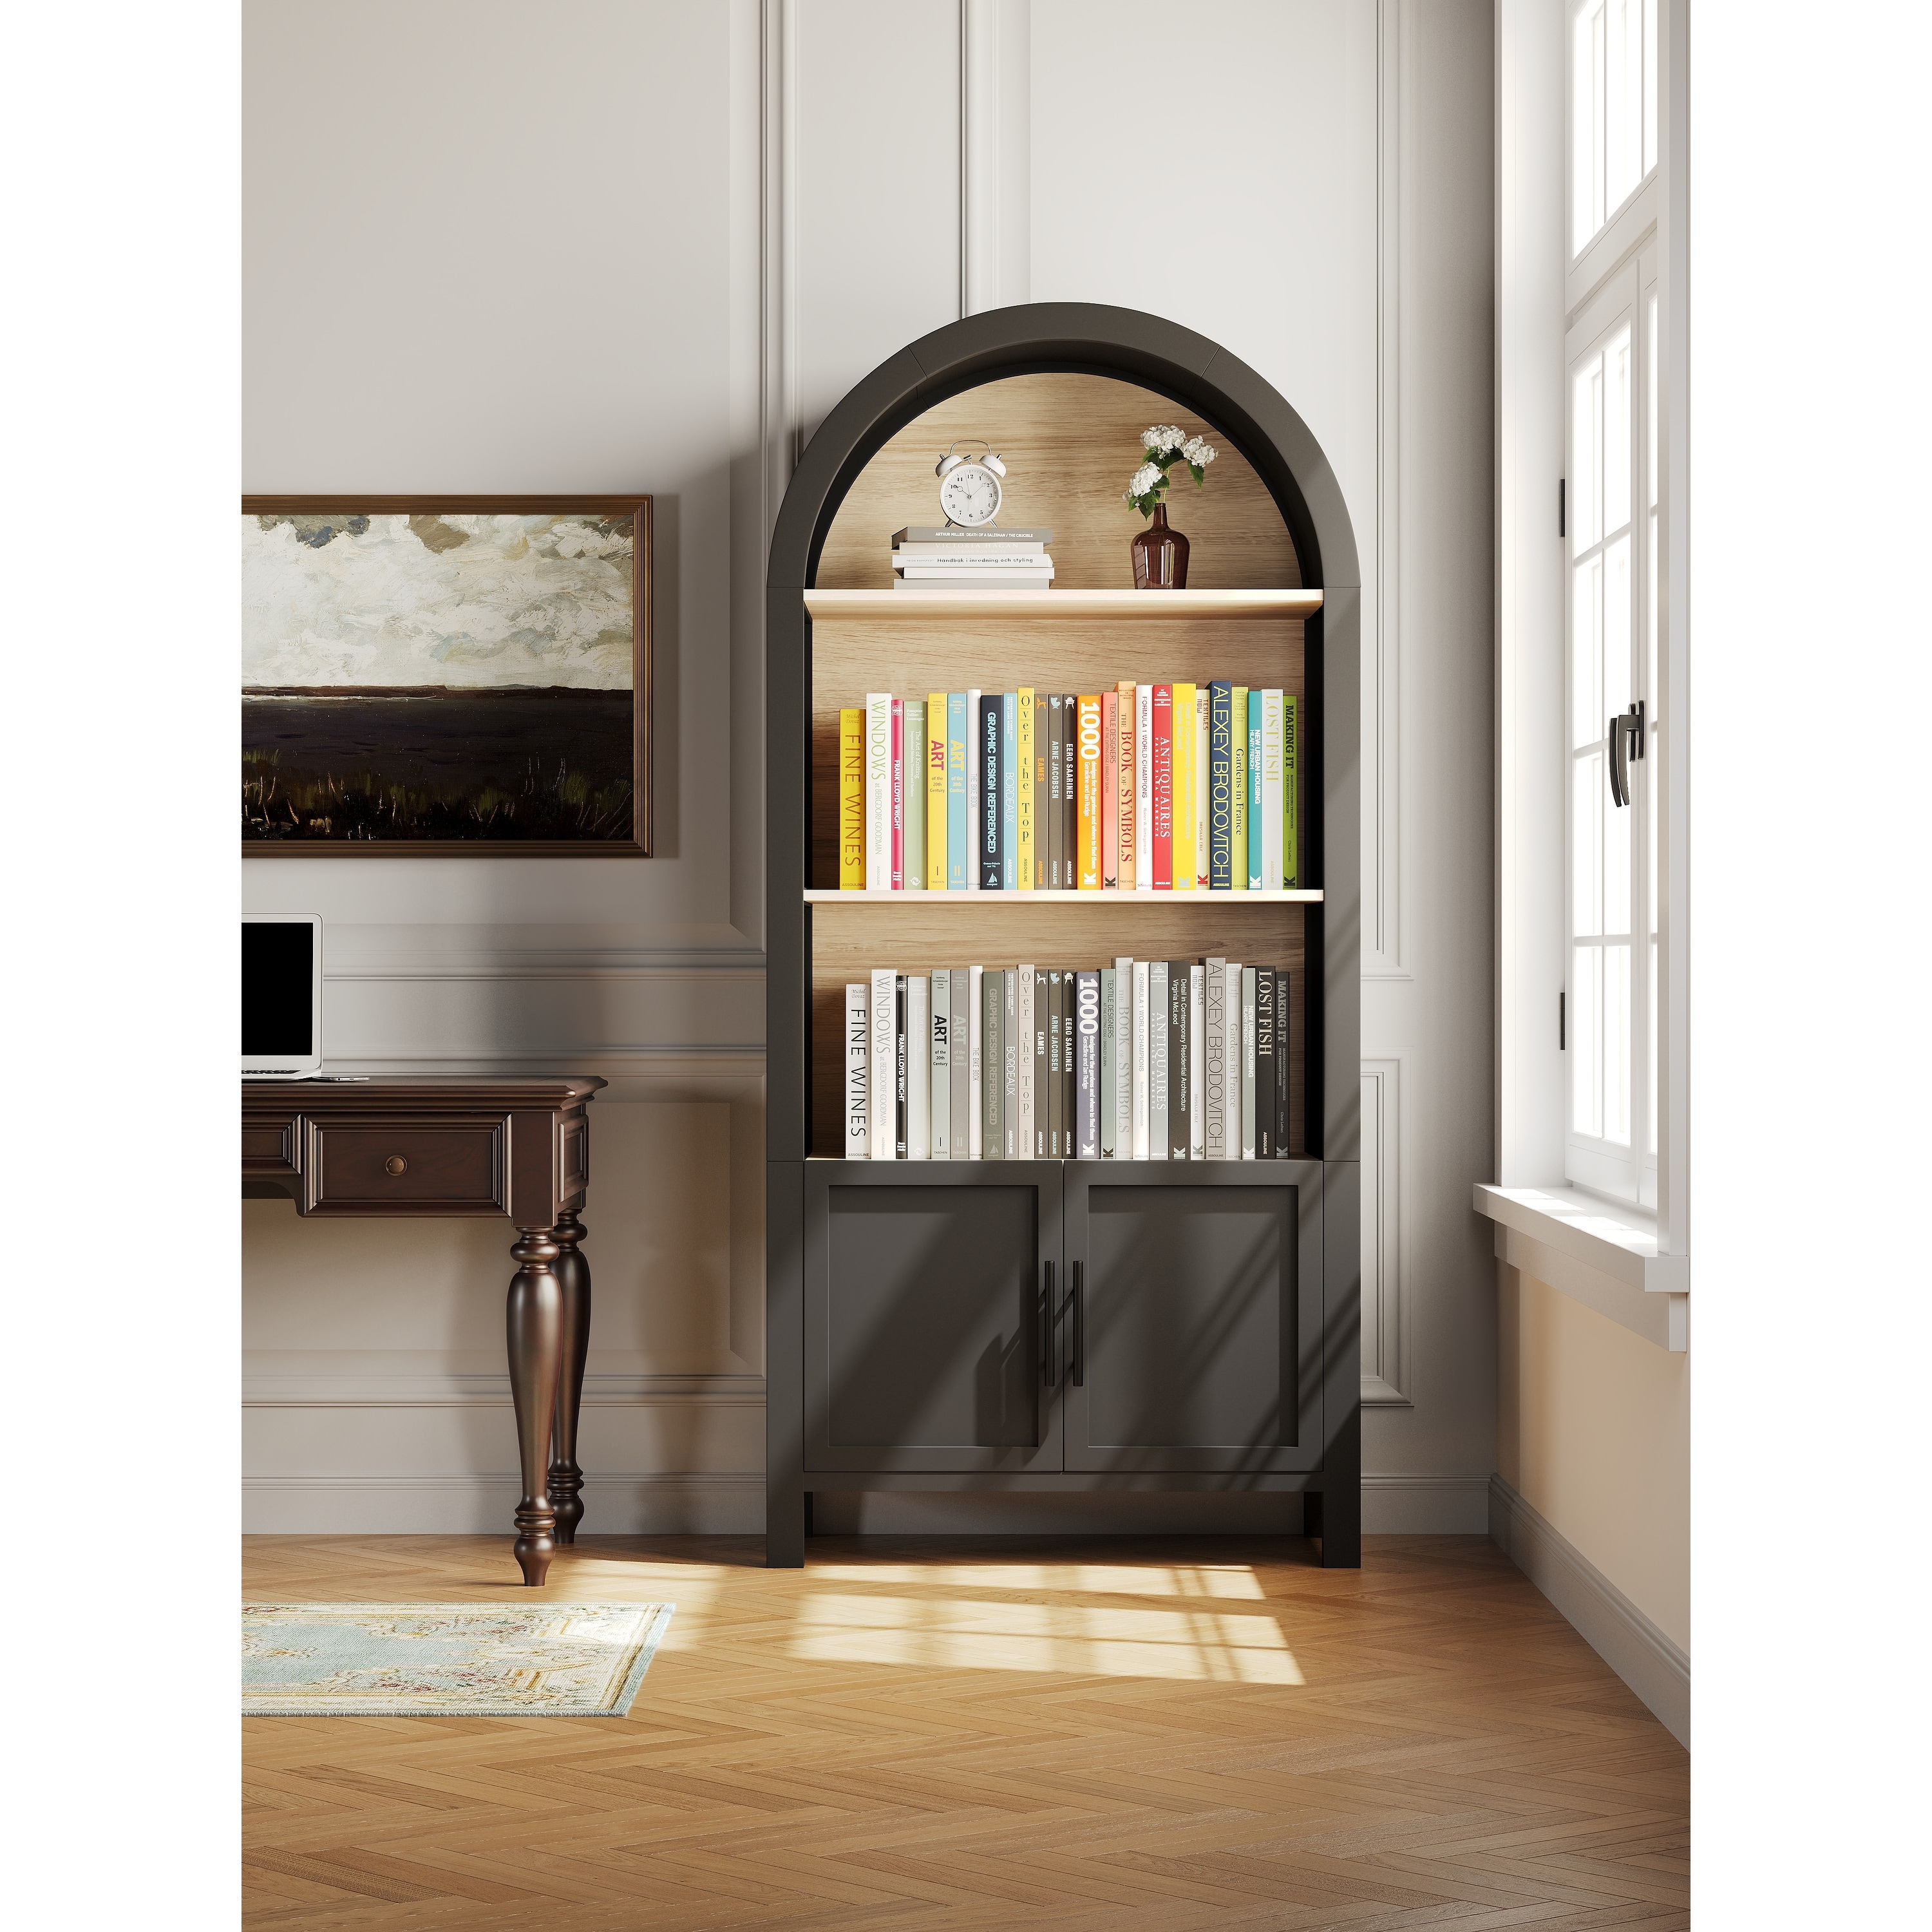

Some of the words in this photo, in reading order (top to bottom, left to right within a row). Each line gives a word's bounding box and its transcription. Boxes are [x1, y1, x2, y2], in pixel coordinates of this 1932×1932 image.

[871, 700, 886, 779] WINDOWS
[1081, 703, 1100, 760] 1000
[1214, 686, 1228, 755] ALEXEY
[1266, 696, 1279, 739] LOST
[846, 735, 860, 782] FINE
[931, 741, 944, 770] ART
[951, 740, 964, 771] ART
[1121, 732, 1132, 773] BOOK
[1266, 745, 1278, 781] FISH
[1286, 757, 1294, 768] IT
[1006, 773, 1014, 823] BORDEAUX
[1121, 777, 1126, 785] OF
[1160, 737, 1170, 837] ANTIQUAIRES
[1236, 791, 1244, 799] in
[846, 793, 860, 866] WINES
[1121, 790, 1132, 861] SYMBOLS
[1213, 762, 1229, 877] BRODOVITCH
[876, 976, 890, 1053] WINDOWS
[1079, 978, 1098, 1034] 1000
[1209, 963, 1222, 1030] ALEXEY
[1259, 971, 1272, 1014] LOST
[851, 1010, 866, 1055] FINE
[934, 1015, 947, 1045] ART
[954, 1015, 966, 1045] ART
[1119, 1007, 1130, 1046] BOOK
[1259, 1018, 1272, 1056] FISH
[1278, 1031, 1286, 1042] IT
[1007, 1046, 1015, 1095] BORDEAUX
[1119, 1050, 1124, 1059] OF
[1157, 1012, 1166, 1110] ANTIQUAIRES
[1230, 1065, 1237, 1073] in
[851, 1066, 866, 1136] WINES
[1119, 1063, 1130, 1133] SYMBOLS
[1209, 1037, 1222, 1148] BRODOVITCH
